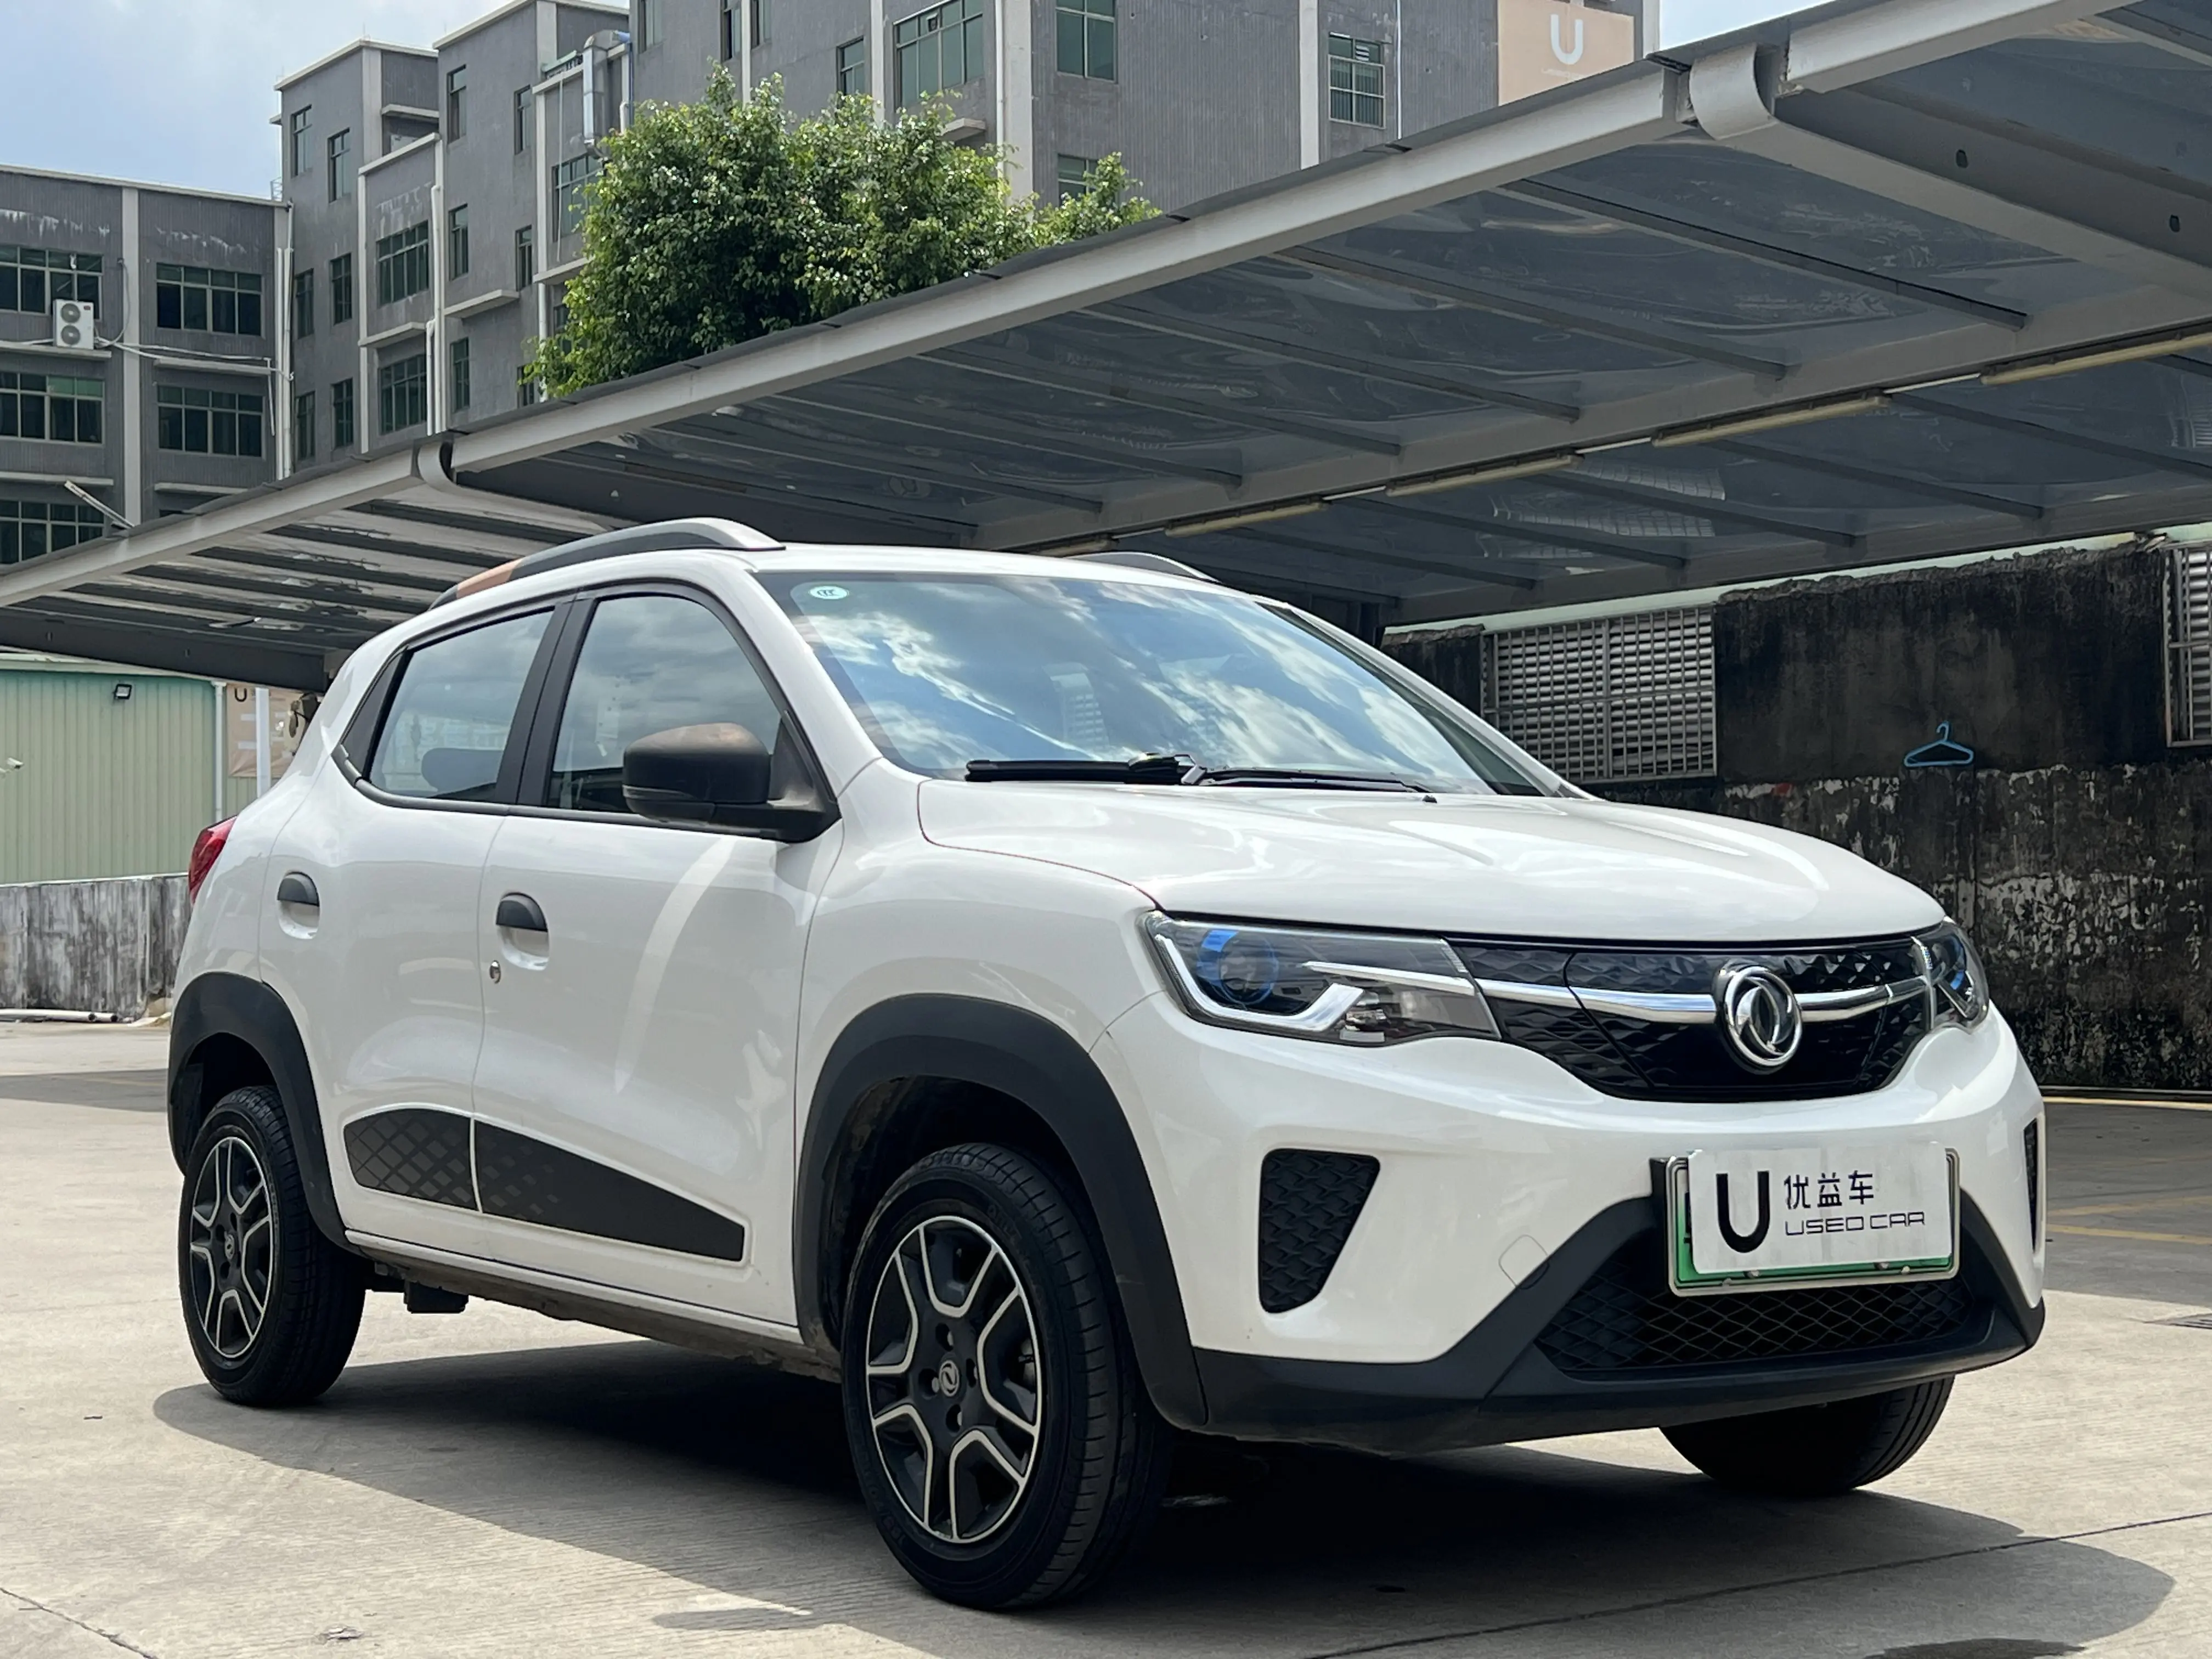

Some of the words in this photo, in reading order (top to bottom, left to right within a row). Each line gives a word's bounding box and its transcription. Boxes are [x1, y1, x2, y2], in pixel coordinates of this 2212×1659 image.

[1550, 14, 1583, 65] U
[234, 687, 247, 702] U
[1784, 1170, 1875, 1210] 优益车
[1716, 1170, 1770, 1254] U
[1785, 1216, 1864, 1236] USED
[1870, 1211, 1926, 1230] CAR
